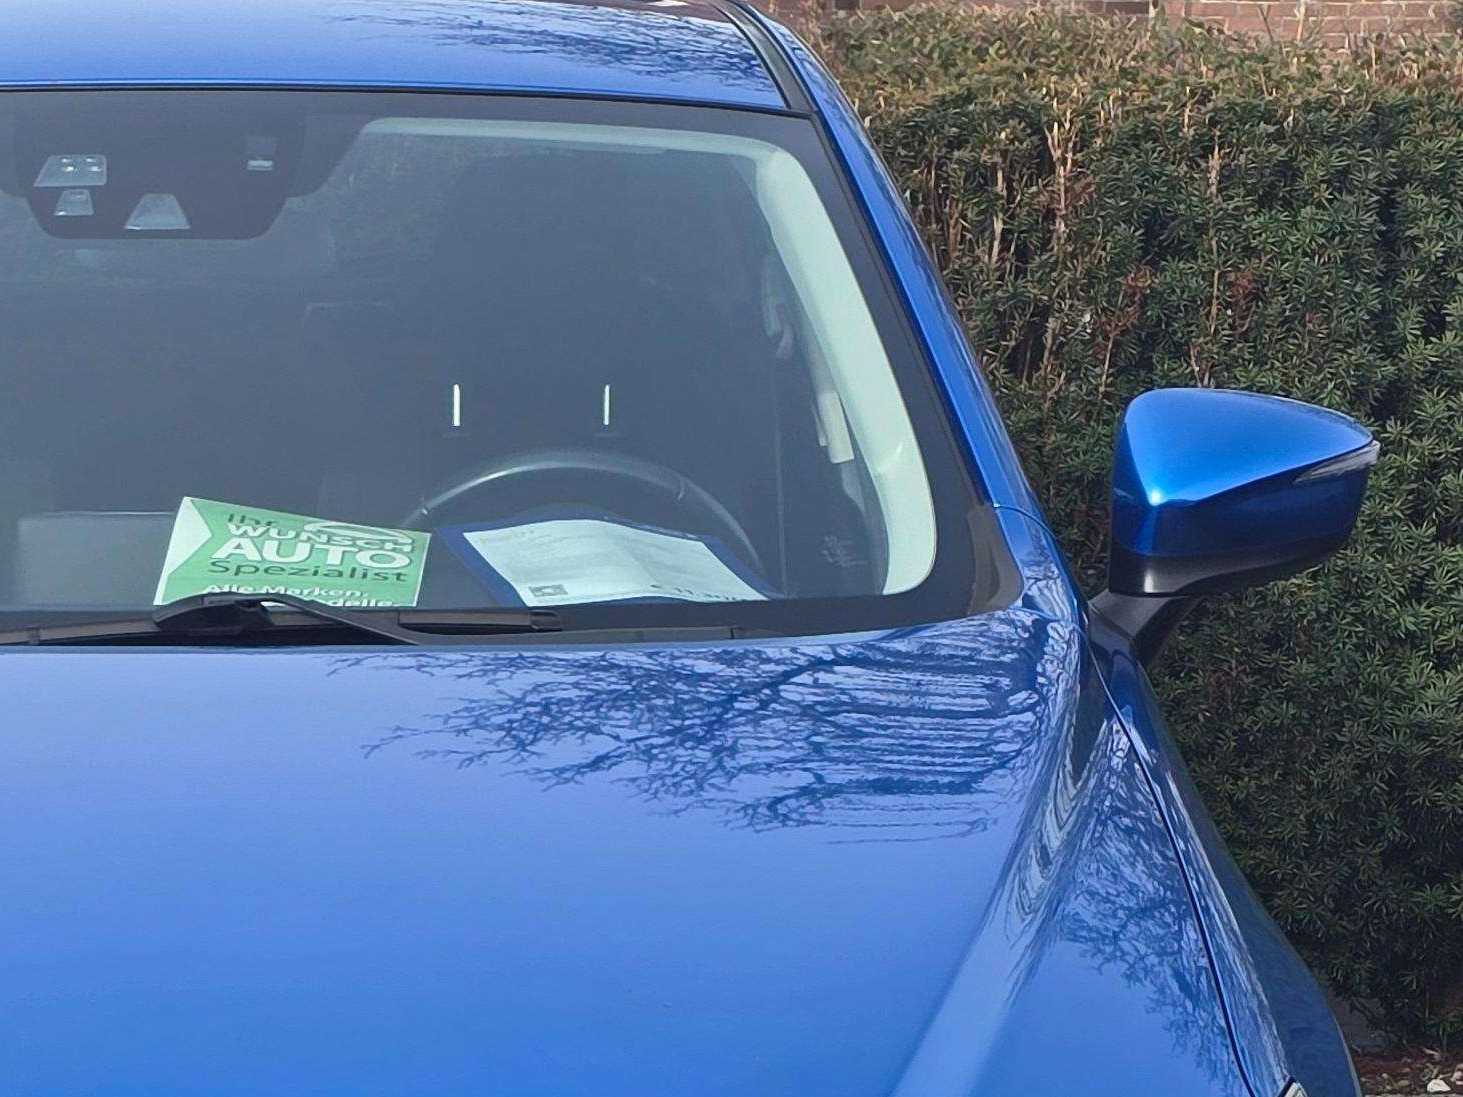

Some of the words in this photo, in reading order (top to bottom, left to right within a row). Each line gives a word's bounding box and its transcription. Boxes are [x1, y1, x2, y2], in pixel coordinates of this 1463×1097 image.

[227, 513, 280, 527] Ihr
[227, 522, 414, 553] WUNSCH
[211, 537, 412, 569] AUTO
[208, 560, 410, 583] Spezialist
